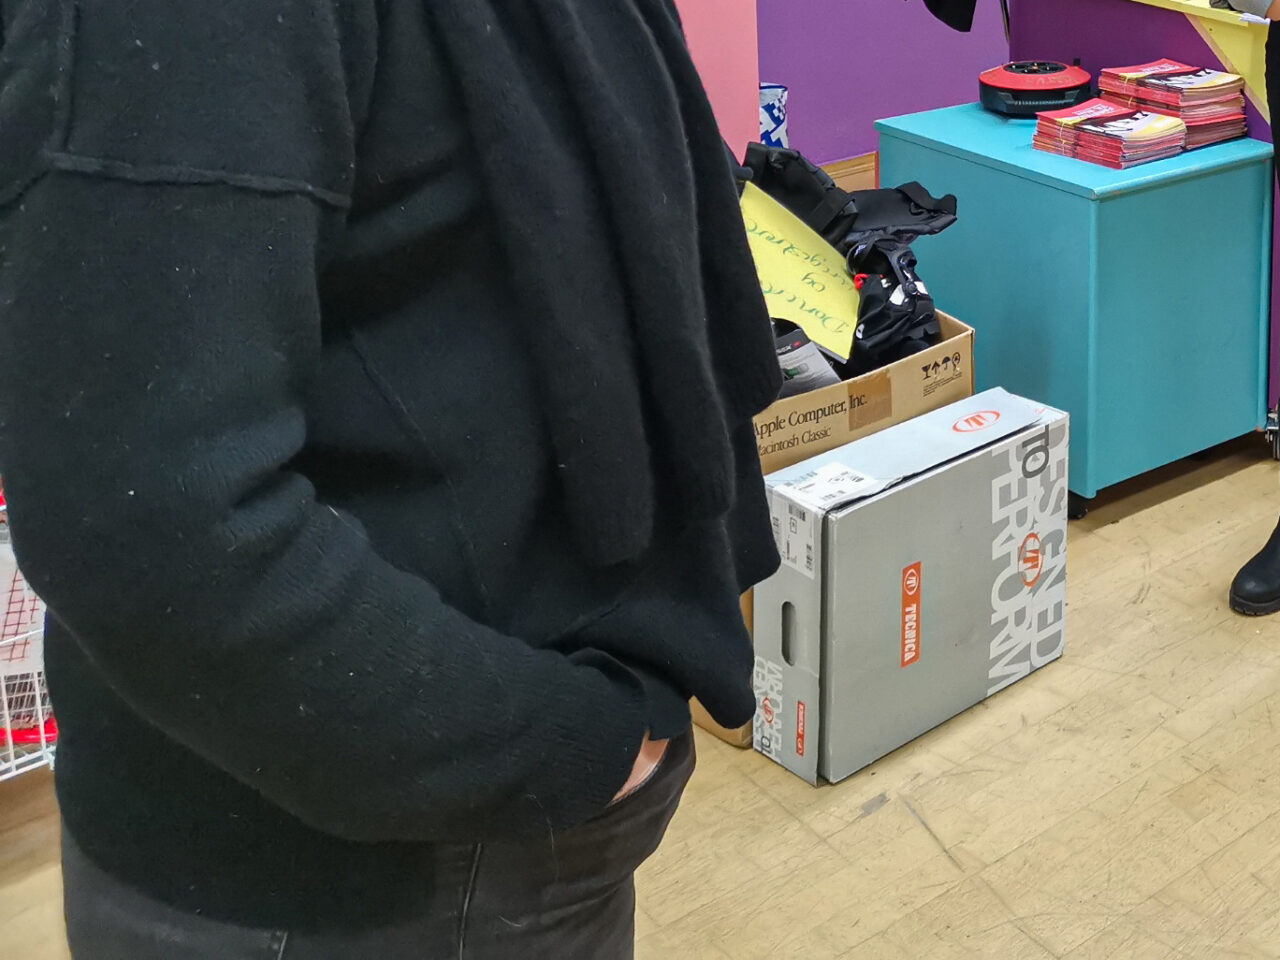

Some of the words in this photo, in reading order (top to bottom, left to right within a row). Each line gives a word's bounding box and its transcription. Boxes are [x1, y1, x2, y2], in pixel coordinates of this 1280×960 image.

[788, 398, 847, 427] Computer,
[848, 392, 868, 411] Inc.
[801, 426, 832, 444] Classic
[1021, 424, 1050, 479] TO
[986, 444, 1033, 697] PERFORM
[1030, 421, 1069, 670] DESIGNED
[904, 603, 917, 663] TECNICA
